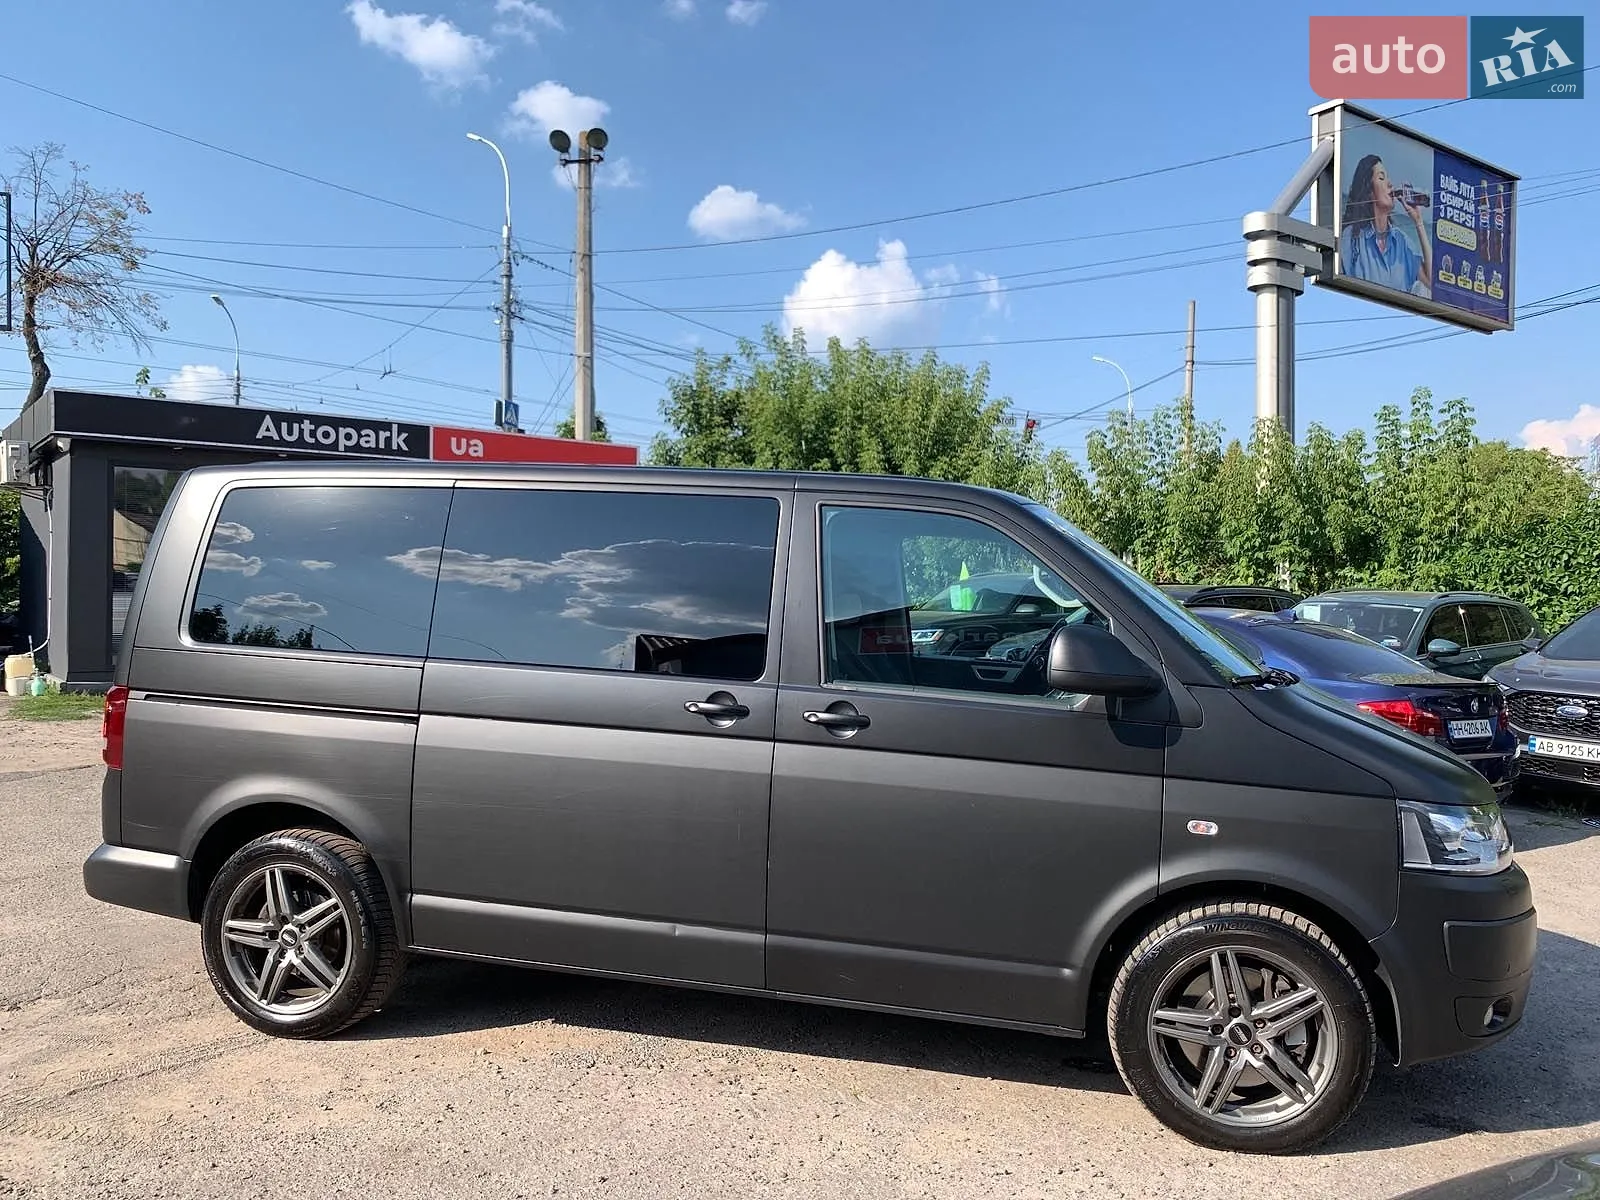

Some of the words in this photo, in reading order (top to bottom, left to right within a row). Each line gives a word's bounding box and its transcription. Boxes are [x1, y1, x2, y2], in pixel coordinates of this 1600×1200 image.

[1459, 182, 1475, 200] ЛІТА
[1440, 191, 1475, 215] ОБИРАЙ
[1446, 206, 1475, 228] PEPSI
[256, 414, 408, 451] Autopark
[450, 437, 484, 457] ua
[1538, 741, 1554, 752] AB
[1557, 743, 1584, 757] 9125
